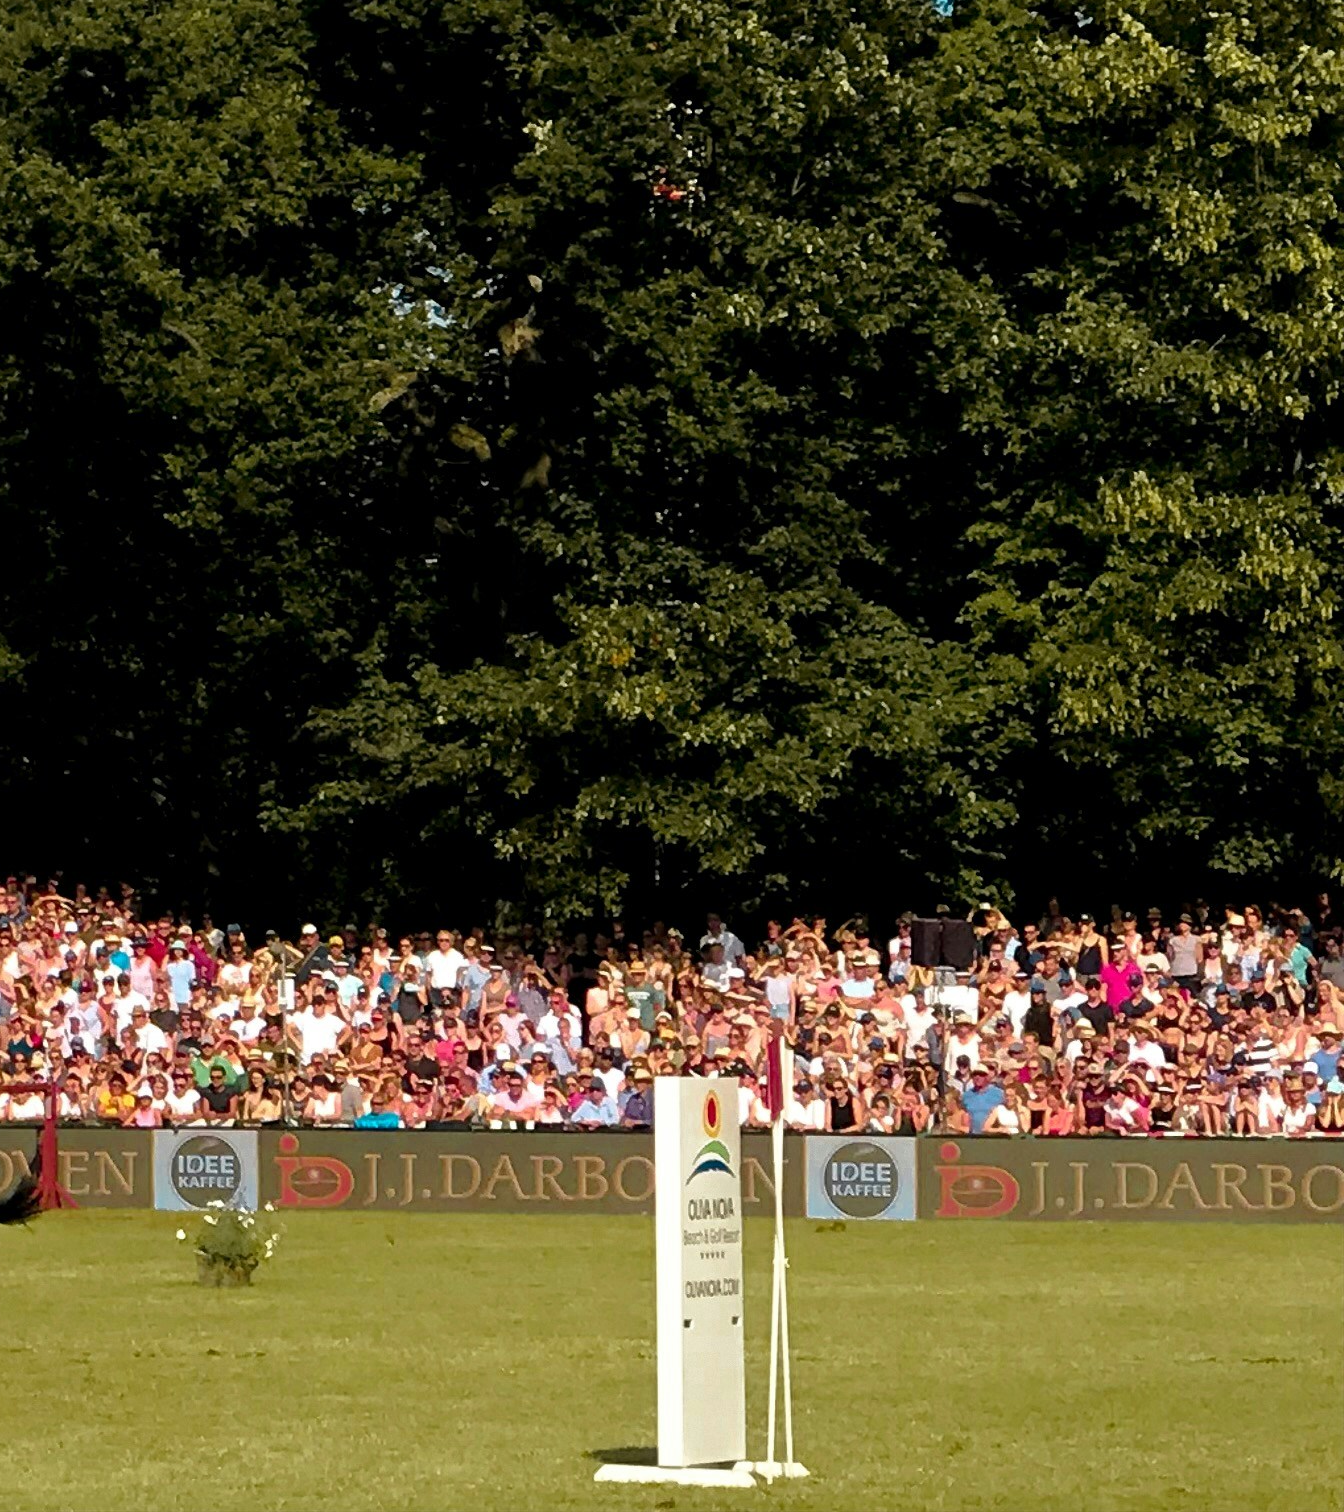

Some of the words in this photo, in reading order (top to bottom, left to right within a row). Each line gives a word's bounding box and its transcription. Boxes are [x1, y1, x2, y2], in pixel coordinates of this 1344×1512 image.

[178, 1155, 234, 1174] IDEE
[831, 1162, 891, 1181] IDEE
[178, 1176, 234, 1188] KAFFEE
[831, 1184, 891, 1196] KAFFEE
